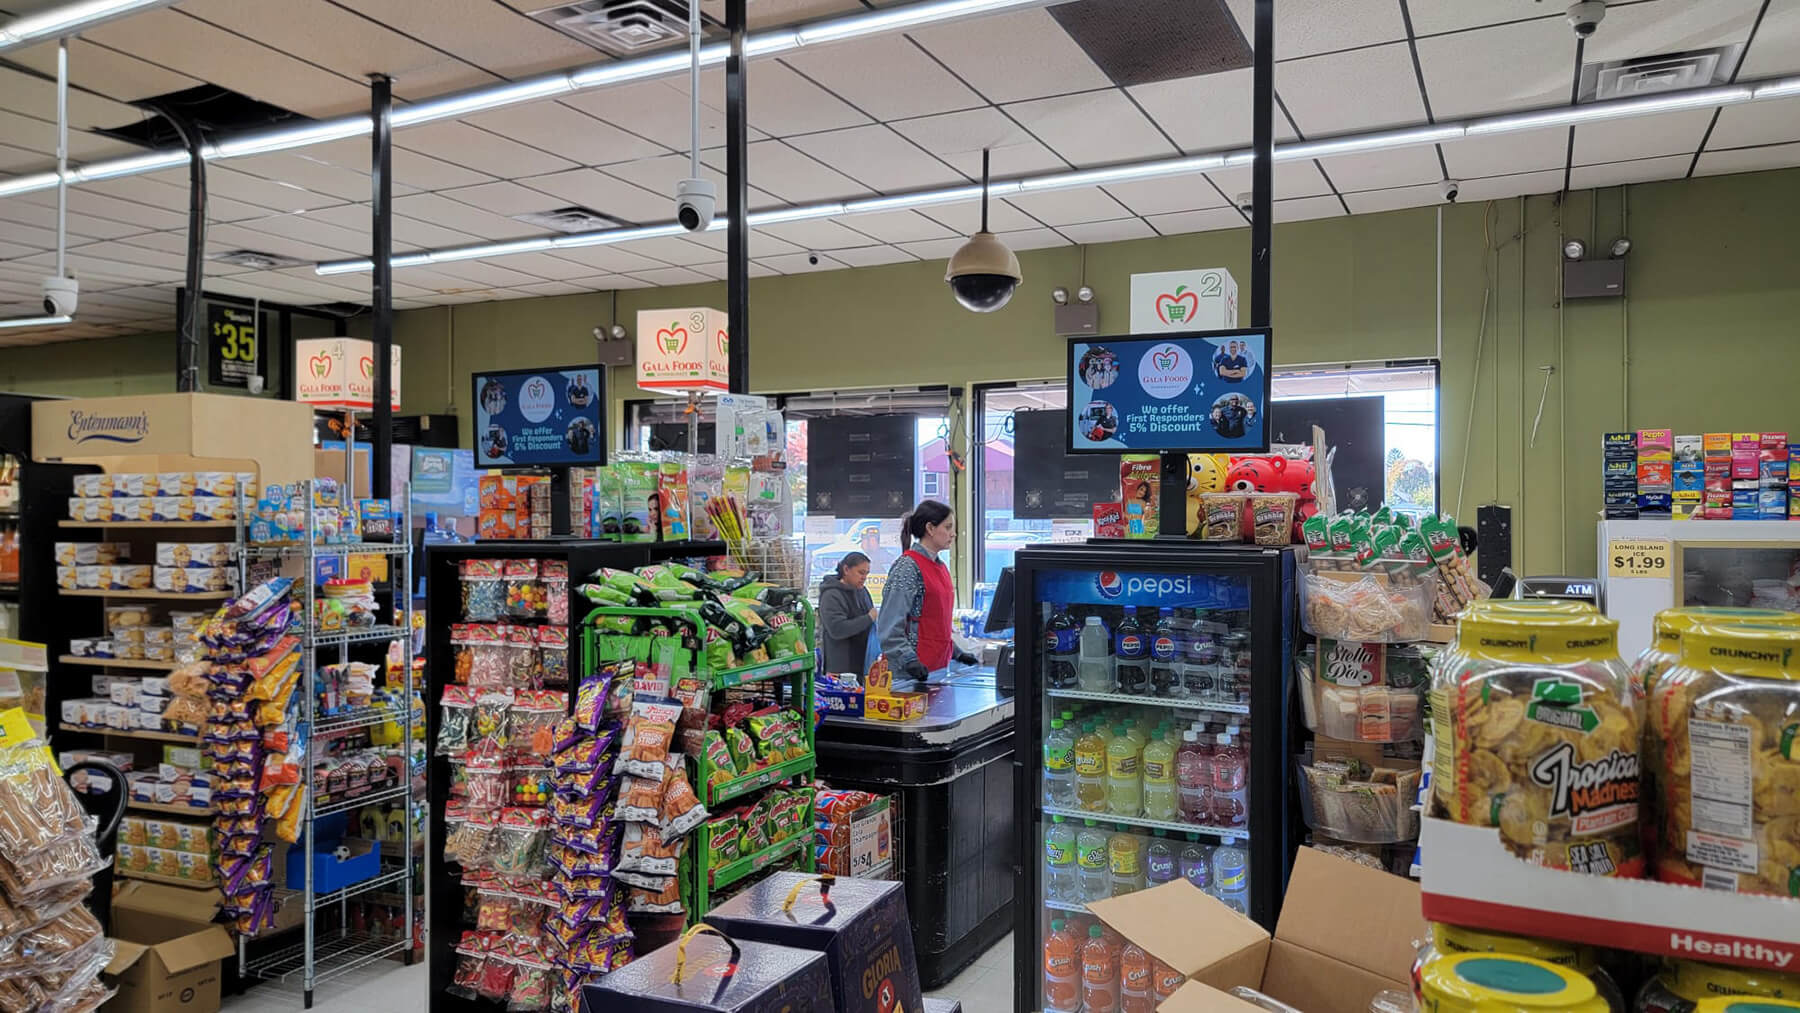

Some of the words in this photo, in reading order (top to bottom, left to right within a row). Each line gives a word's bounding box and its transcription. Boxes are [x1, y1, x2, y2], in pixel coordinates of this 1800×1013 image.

[1201, 272, 1222, 298] 2
[689, 311, 705, 334] 3
[332, 341, 344, 361] 4
[642, 361, 670, 372] GALA
[672, 360, 703, 372] FOODS
[1141, 405, 1158, 414] We
[1160, 404, 1189, 414] offer
[67, 409, 150, 441] Entenmann's
[1126, 415, 1148, 423] First
[1150, 413, 1205, 423] Responders
[1129, 422, 1147, 432] 5%
[1150, 421, 1201, 432] Discount
[527, 441, 561, 450] Discount
[1613, 556, 1665, 569] $1.99
[1127, 575, 1192, 597] pepsi
[1565, 584, 1593, 595] ATM
[1479, 637, 1527, 649] CRUNCHY!
[1709, 646, 1781, 663] CRUNCHY!
[1535, 704, 1583, 728] ORIGINAL
[1670, 932, 1794, 968] Healthy
[863, 945, 902, 999] GLORIA
